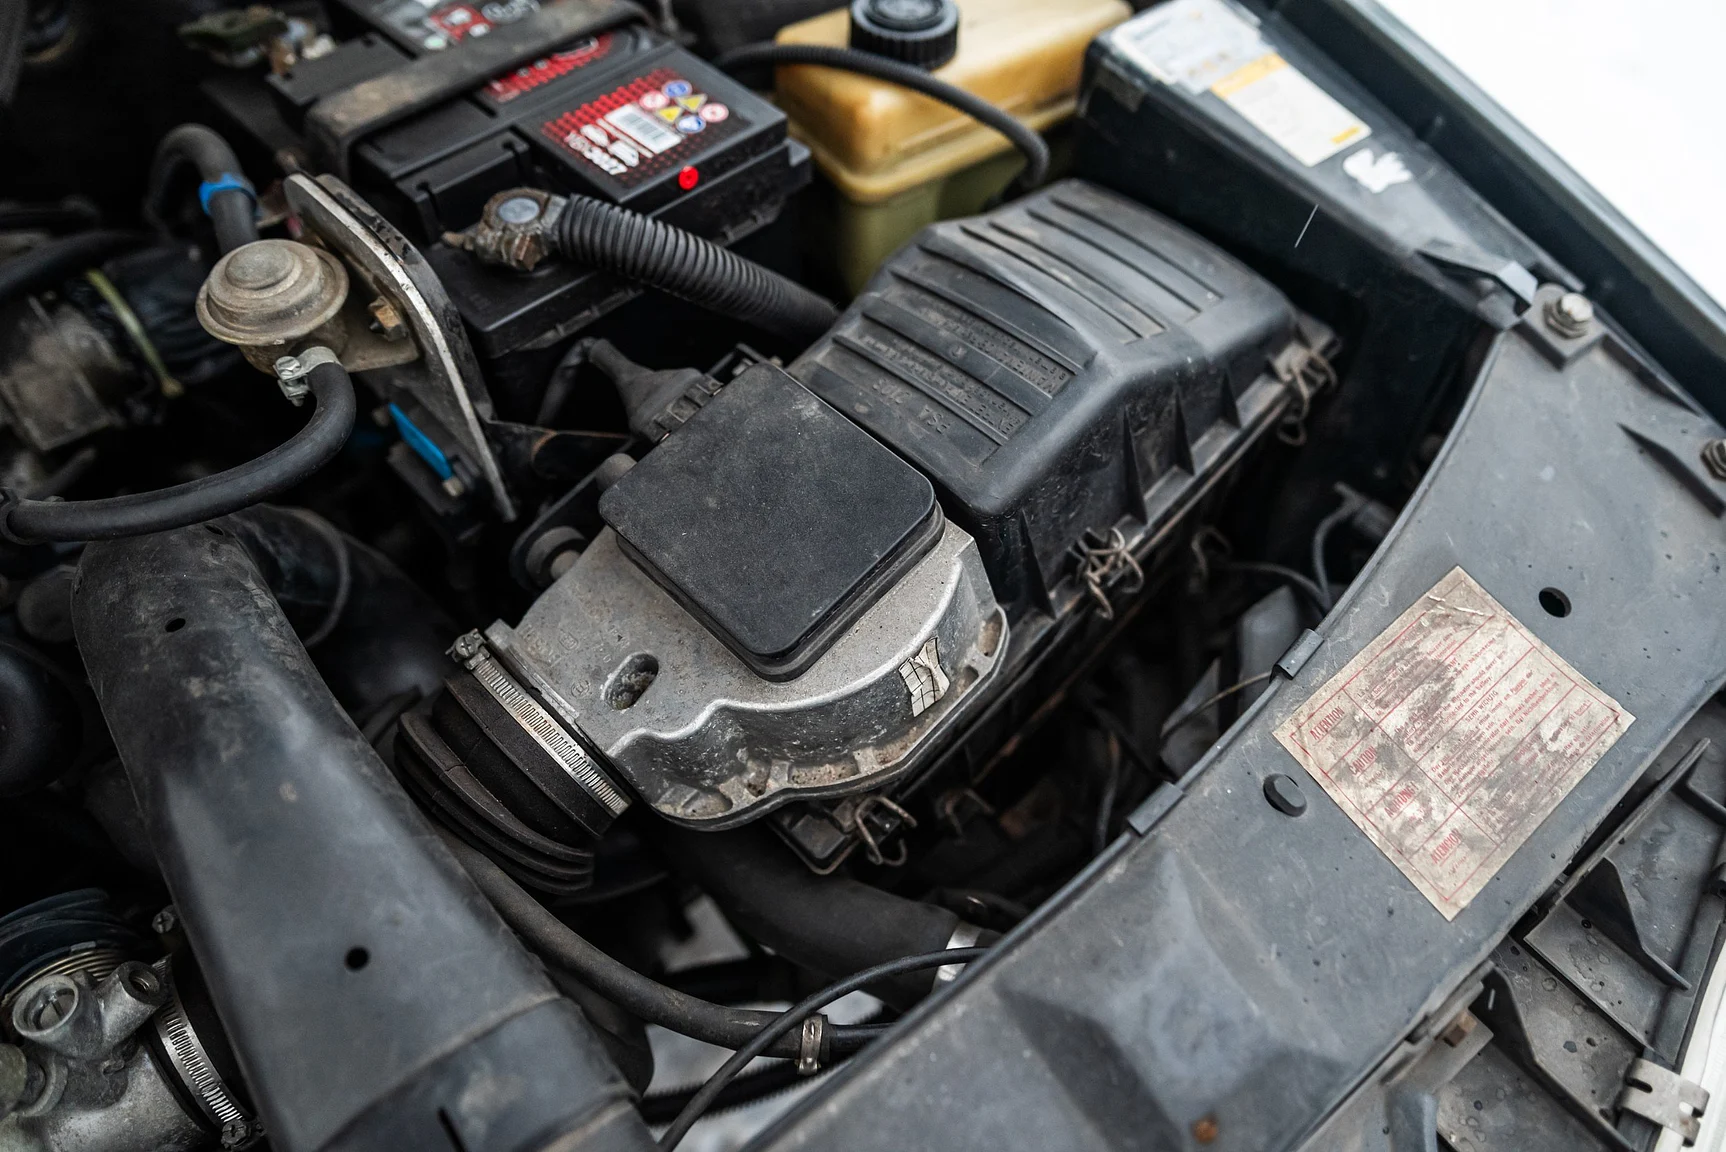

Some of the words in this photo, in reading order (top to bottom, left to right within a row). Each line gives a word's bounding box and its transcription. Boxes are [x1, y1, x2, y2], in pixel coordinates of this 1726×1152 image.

[1461, 695, 1470, 704] to
[1467, 689, 1477, 698] the
[1307, 704, 1346, 740] ATTENTION
[1498, 717, 1509, 729] darf
[1506, 702, 1525, 720] niemals
[1346, 744, 1379, 776] CAUTION
[1430, 762, 1441, 773] Der
